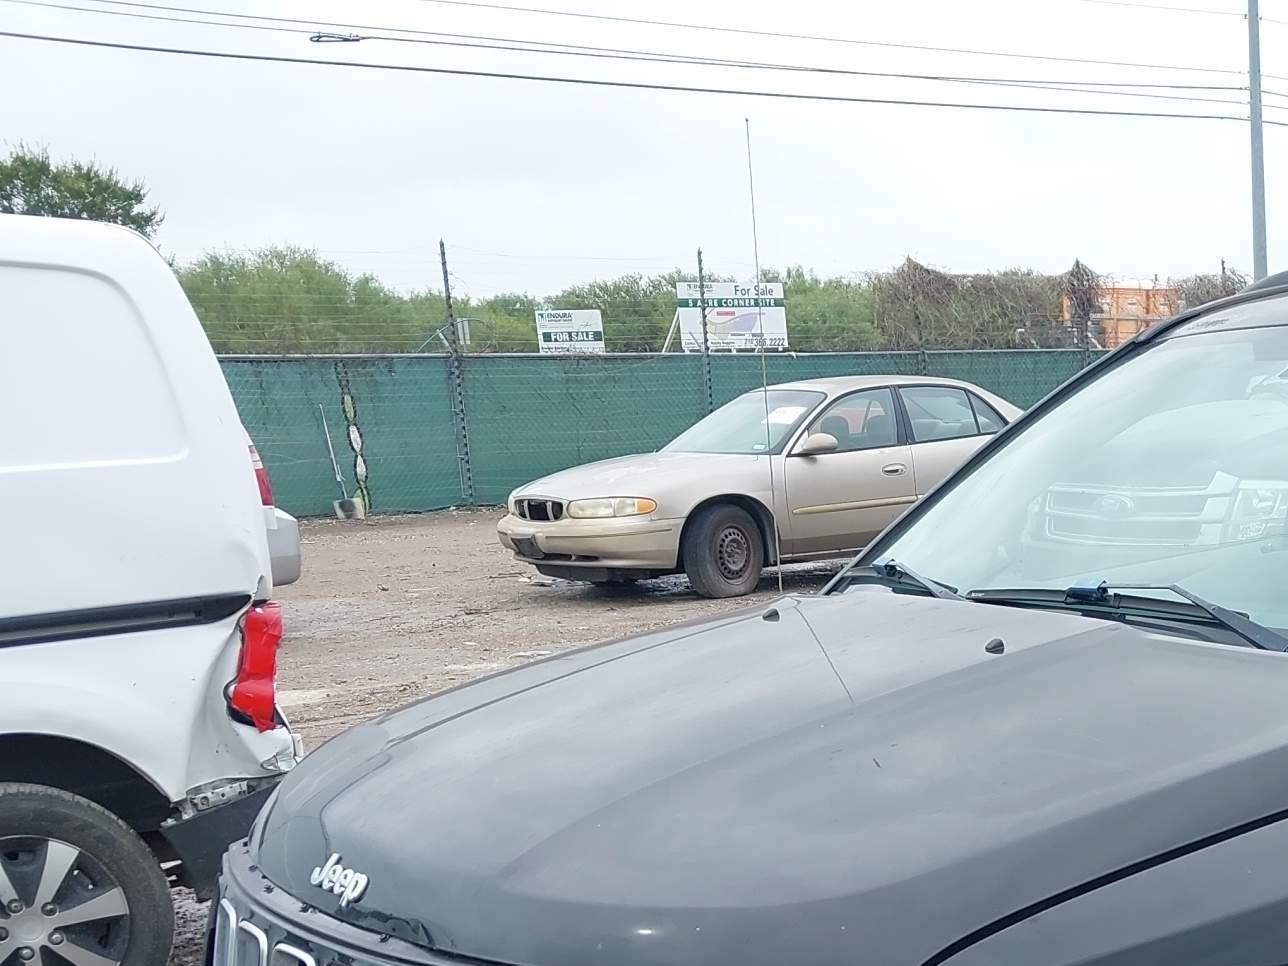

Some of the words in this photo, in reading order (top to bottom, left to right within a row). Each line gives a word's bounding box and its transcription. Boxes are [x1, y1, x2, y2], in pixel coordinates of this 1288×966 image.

[734, 285, 751, 297] For
[753, 284, 774, 297] Sale
[688, 298, 693, 307] 5
[721, 298, 755, 307] CORNER
[757, 298, 775, 307] SITE
[551, 332, 570, 342] FOR
[571, 331, 595, 342] SALE
[310, 852, 368, 907] Jeep
